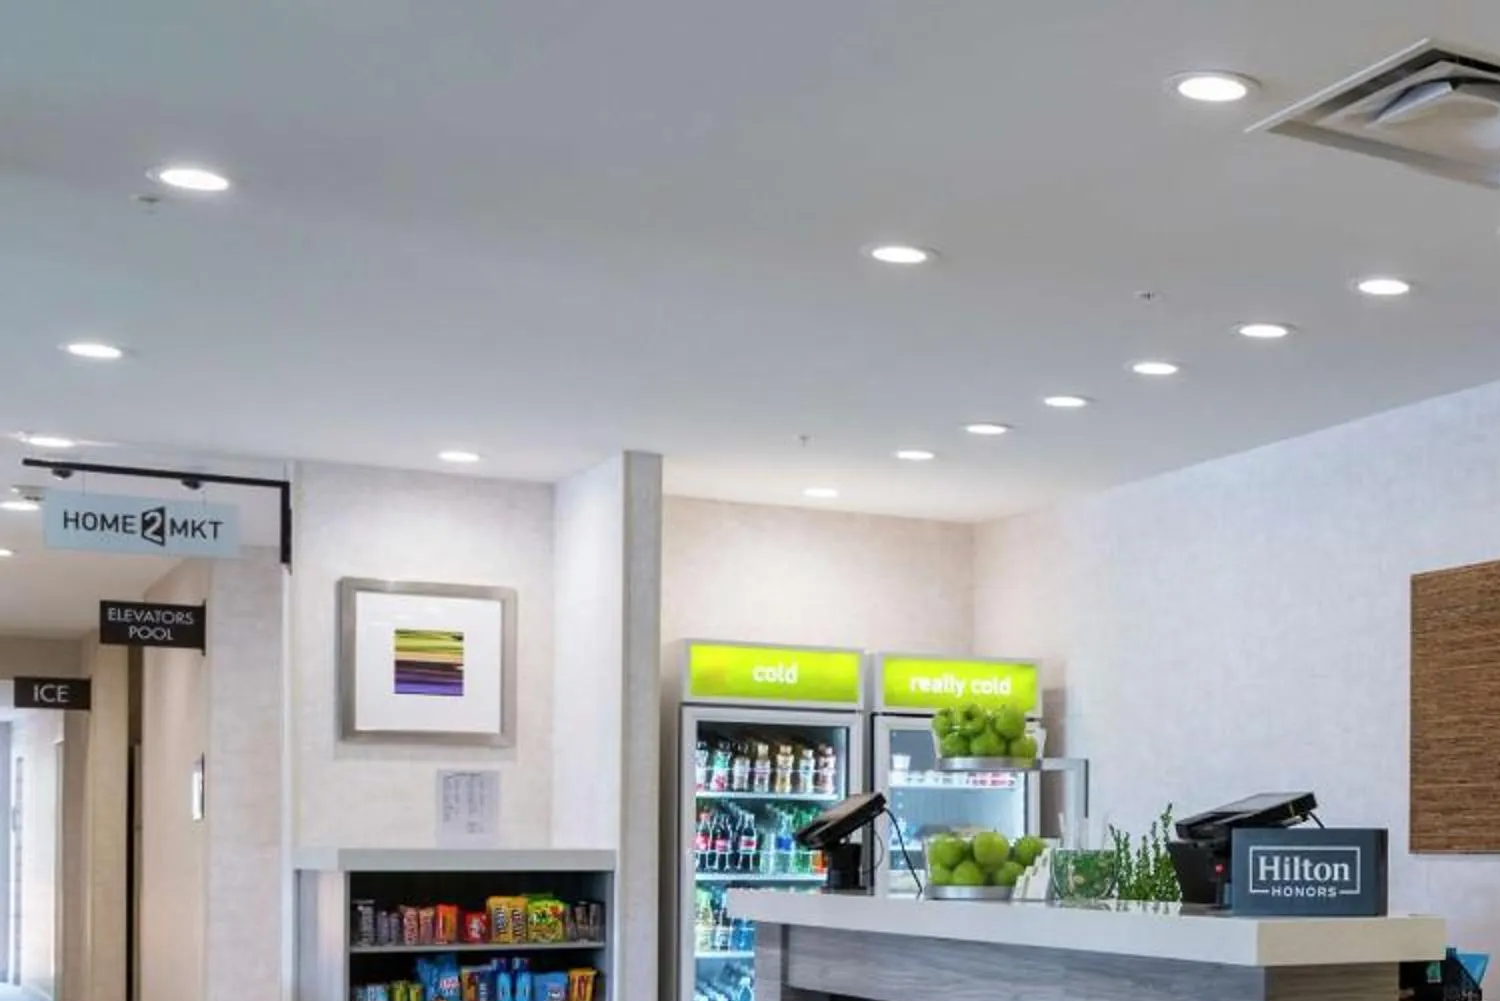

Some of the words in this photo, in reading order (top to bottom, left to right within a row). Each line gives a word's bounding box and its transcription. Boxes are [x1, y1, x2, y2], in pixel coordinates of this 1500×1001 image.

[108, 607, 194, 624] ELEVATORS
[129, 625, 174, 641] POOL
[752, 663, 799, 685] cold
[33, 684, 70, 703] ICE
[910, 674, 964, 698] really
[971, 676, 1012, 695] cold
[1259, 855, 1350, 882] Hilton
[1271, 885, 1337, 898] HONORS
